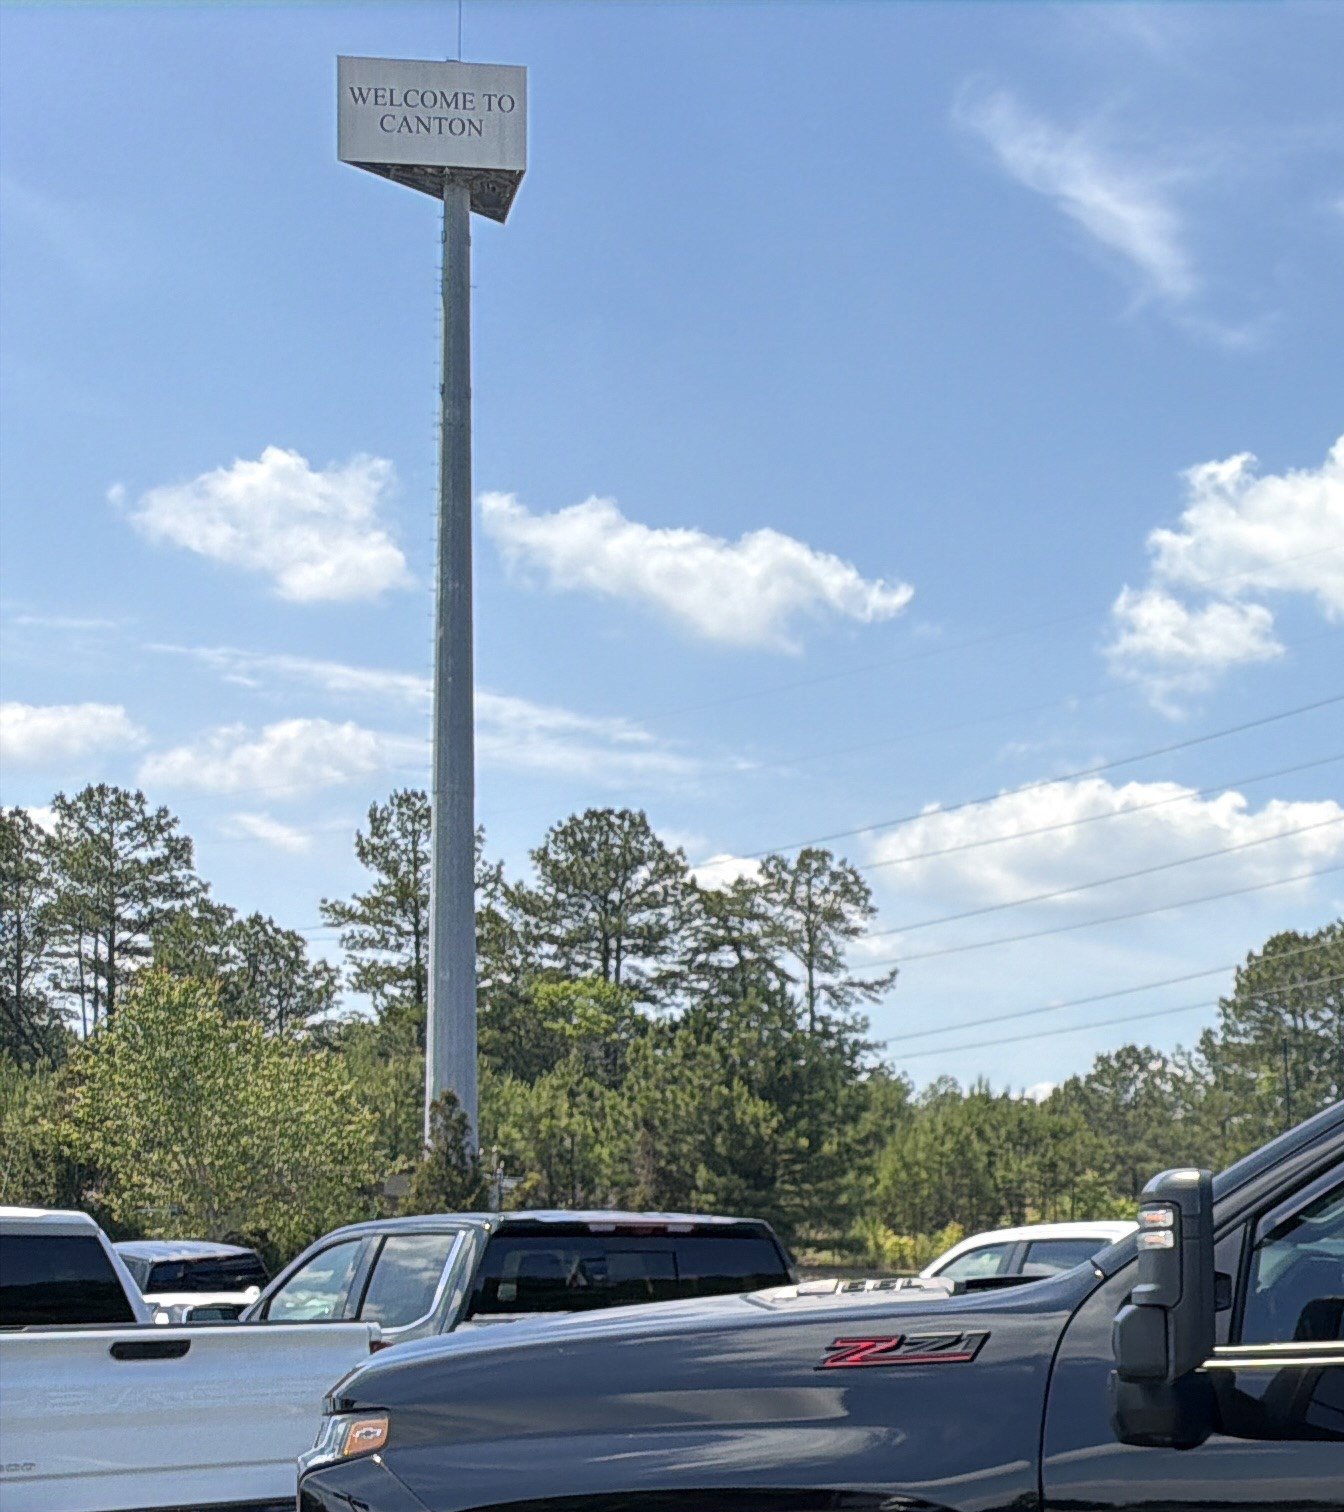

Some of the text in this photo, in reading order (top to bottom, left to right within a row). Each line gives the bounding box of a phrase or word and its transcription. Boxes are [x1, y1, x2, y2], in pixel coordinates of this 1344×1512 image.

[349, 86, 515, 113] WELCOME TO
[379, 113, 484, 137] CANTON
[814, 1330, 991, 1371] Z71
